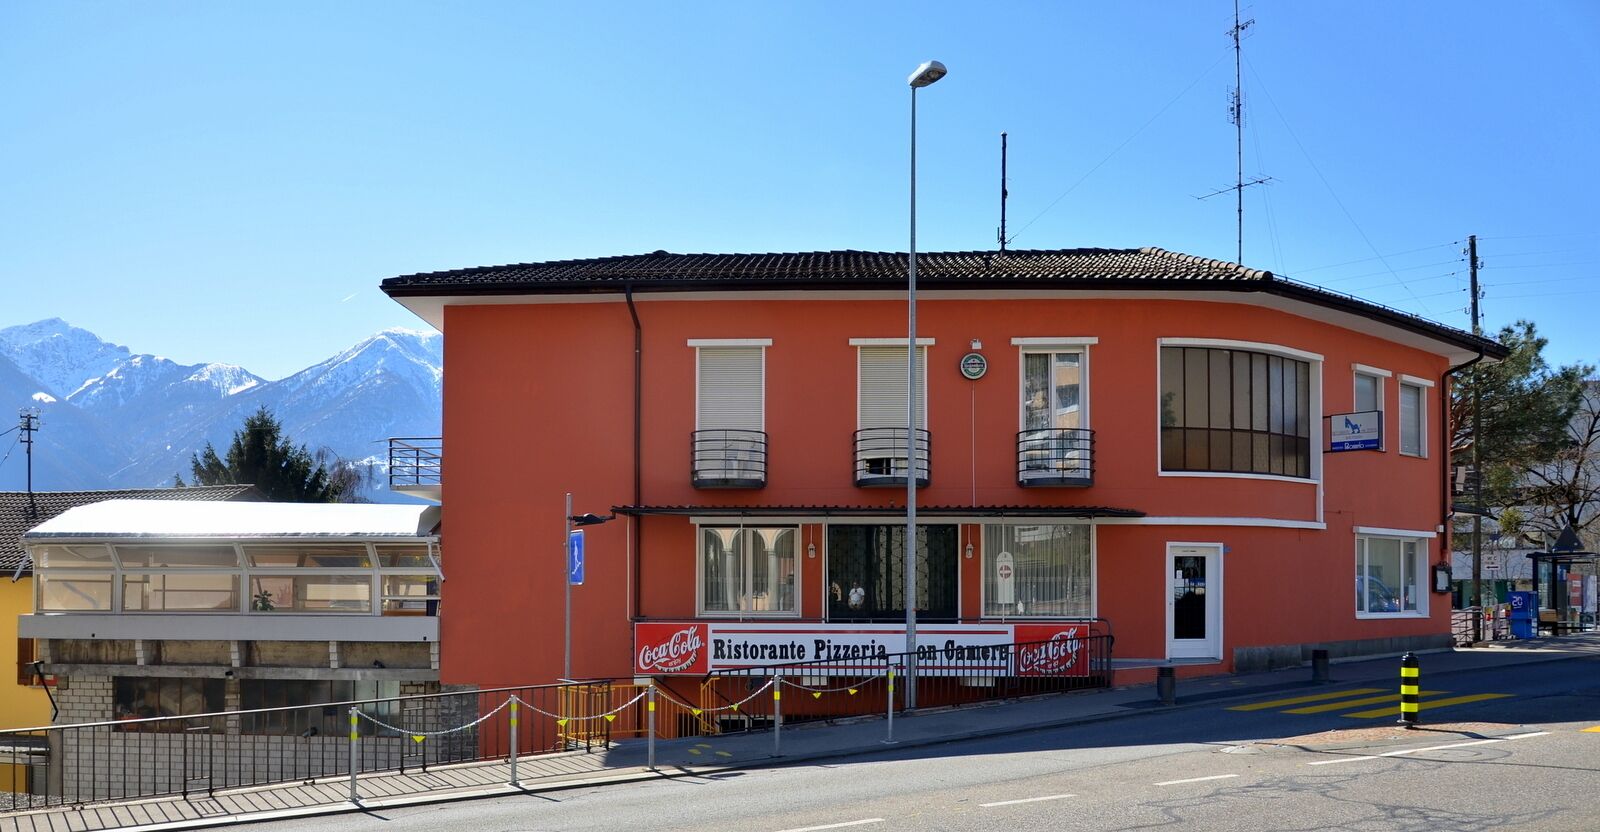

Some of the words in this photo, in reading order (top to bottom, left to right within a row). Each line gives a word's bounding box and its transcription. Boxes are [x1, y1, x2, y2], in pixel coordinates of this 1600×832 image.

[639, 625, 701, 670] Coca-Cola
[713, 639, 806, 659] Ristorante
[814, 639, 887, 660] Pizzeria
[906, 644, 938, 660] on
